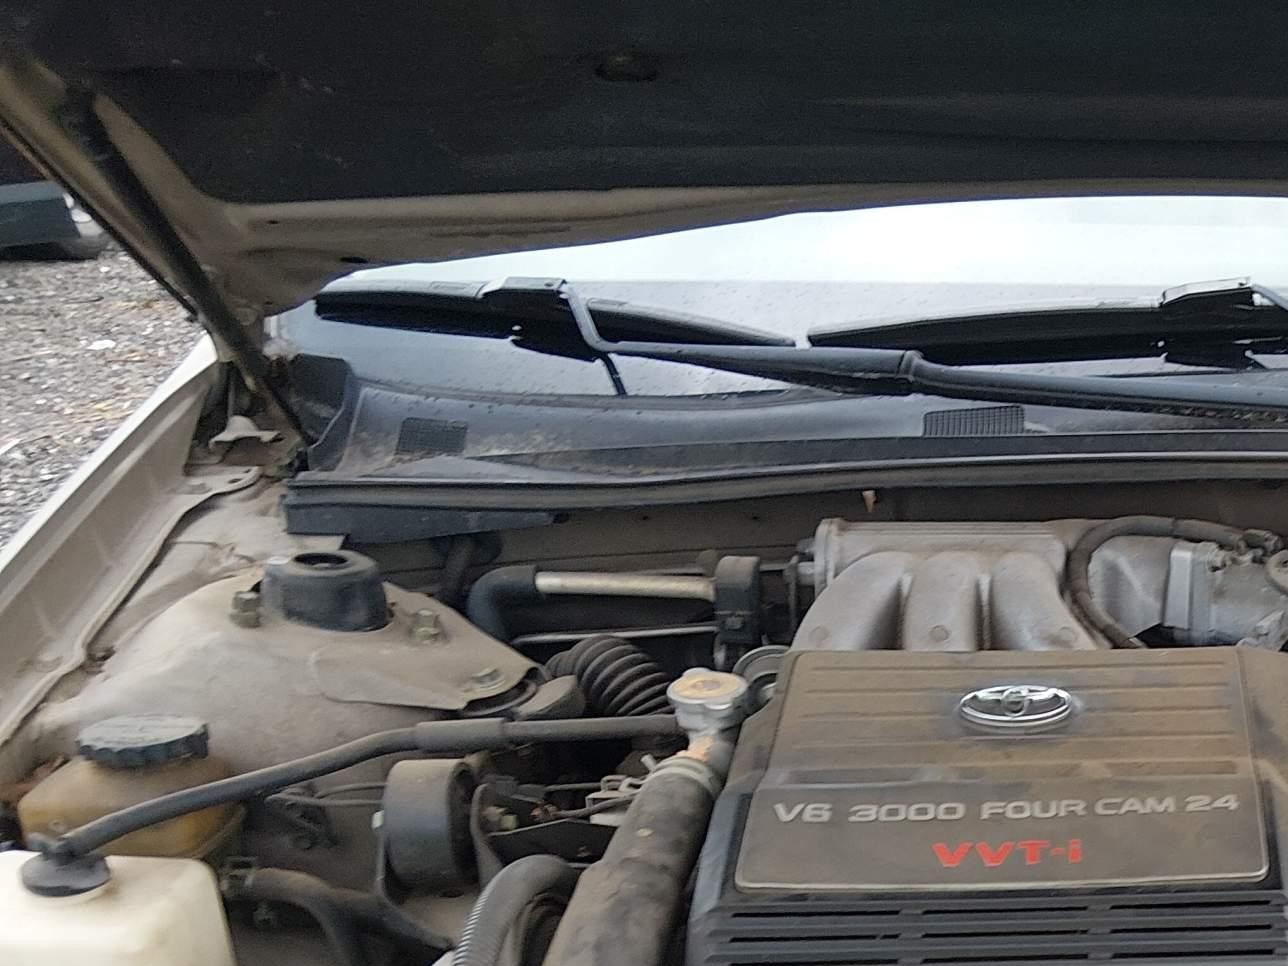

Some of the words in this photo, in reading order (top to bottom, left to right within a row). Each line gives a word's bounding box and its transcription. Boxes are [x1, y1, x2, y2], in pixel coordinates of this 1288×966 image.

[773, 803, 833, 822] V6
[848, 803, 966, 822] 3000
[979, 800, 1088, 819] FOUR
[1094, 797, 1177, 816] CAM
[1184, 794, 1241, 812] 24
[932, 839, 1082, 867] VVT-i
